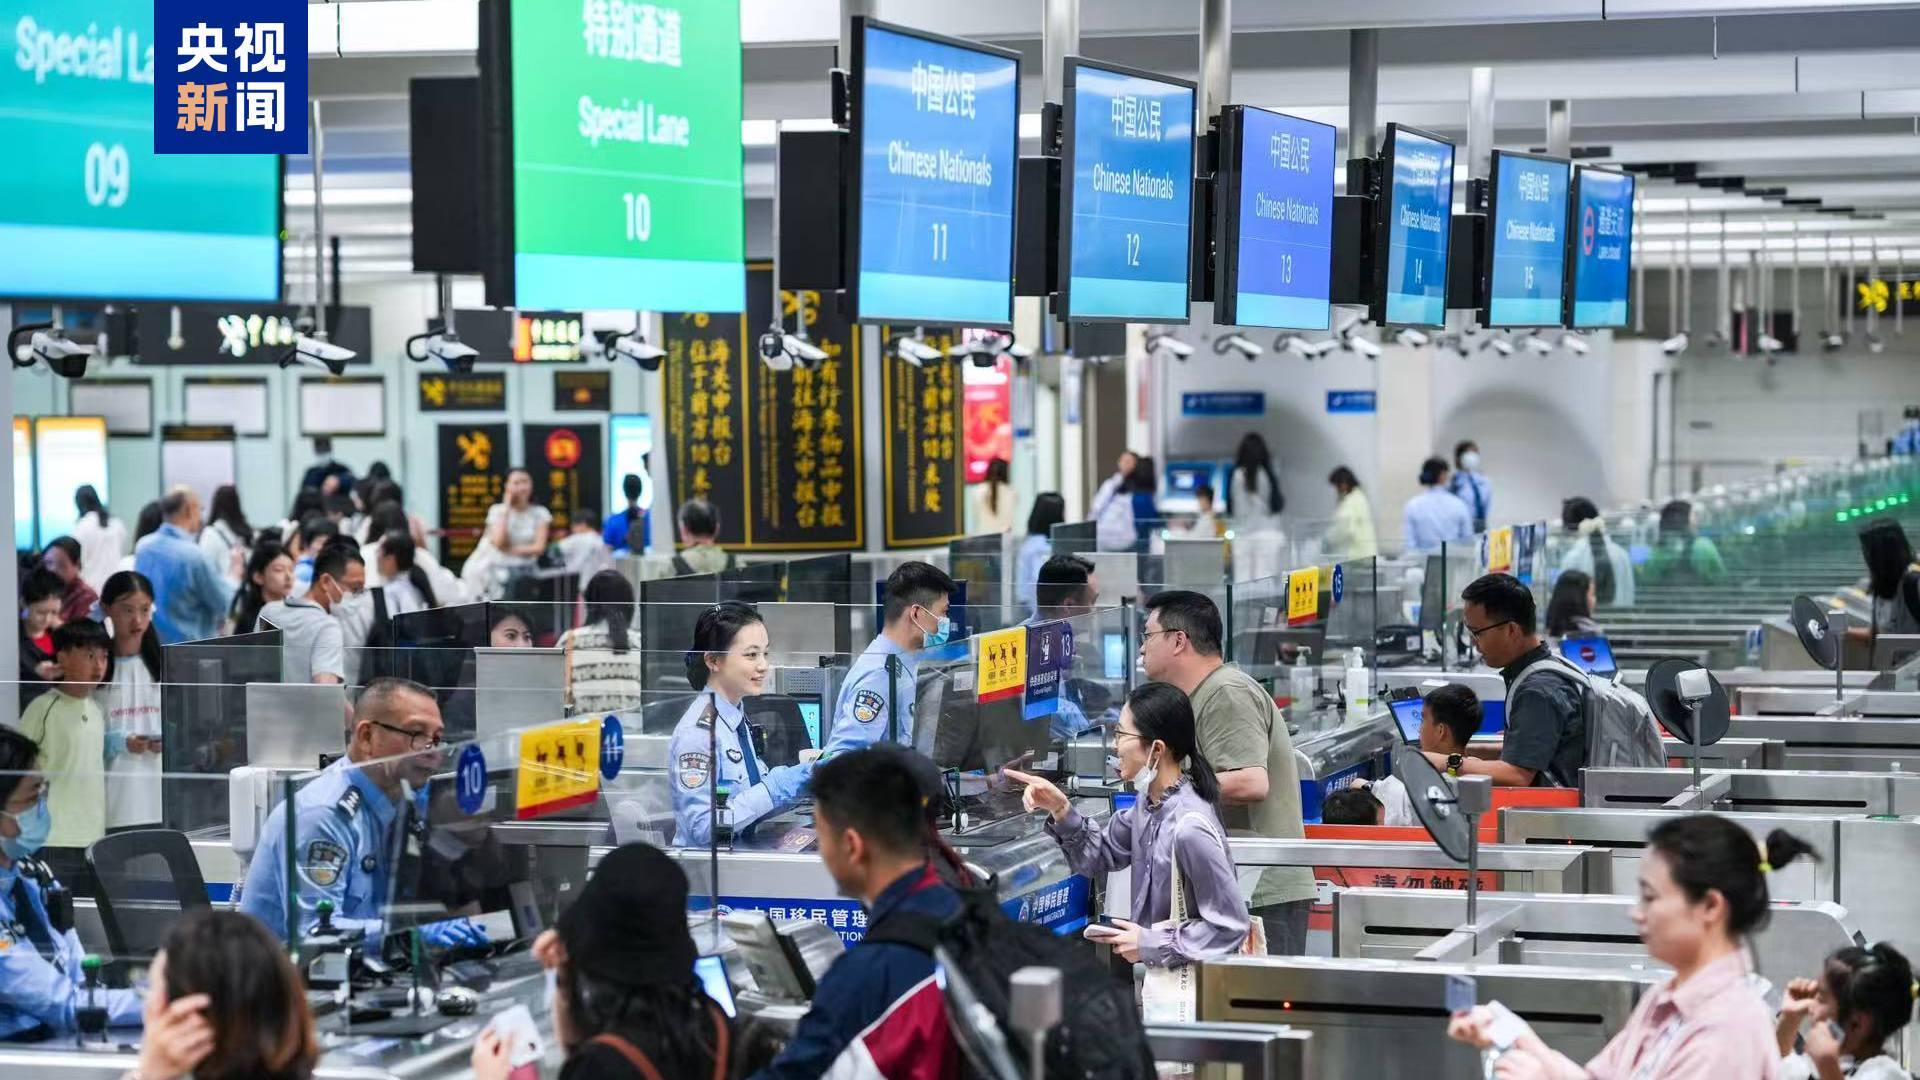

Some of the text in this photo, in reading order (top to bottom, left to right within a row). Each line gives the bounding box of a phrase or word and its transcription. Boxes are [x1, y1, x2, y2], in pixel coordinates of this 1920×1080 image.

[16, 15, 154, 84] Special La
[582, 0, 682, 67] 特别通道
[911, 59, 976, 120] 中国公民
[578, 95, 689, 147] Special Lane
[1111, 91, 1162, 142] 中国公民
[888, 139, 993, 187] Chinese Nationals
[1270, 130, 1311, 175] 中国公民
[84, 141, 130, 208] 09
[1093, 163, 1174, 201] Chinese Nationals
[623, 192, 651, 242] 10
[1256, 193, 1319, 226] Chinese Nationals
[1400, 204, 1441, 233] Chinese Nationals
[932, 223, 948, 261] 11
[1506, 219, 1555, 242] Chinese Nationals
[1126, 233, 1140, 267] 12
[1280, 253, 1292, 284] 13
[1415, 258, 1422, 284] 14
[1525, 266, 1534, 289] 15
[1061, 634, 1071, 657] 13
[604, 732, 619, 764] 11
[462, 762, 480, 797] 10
